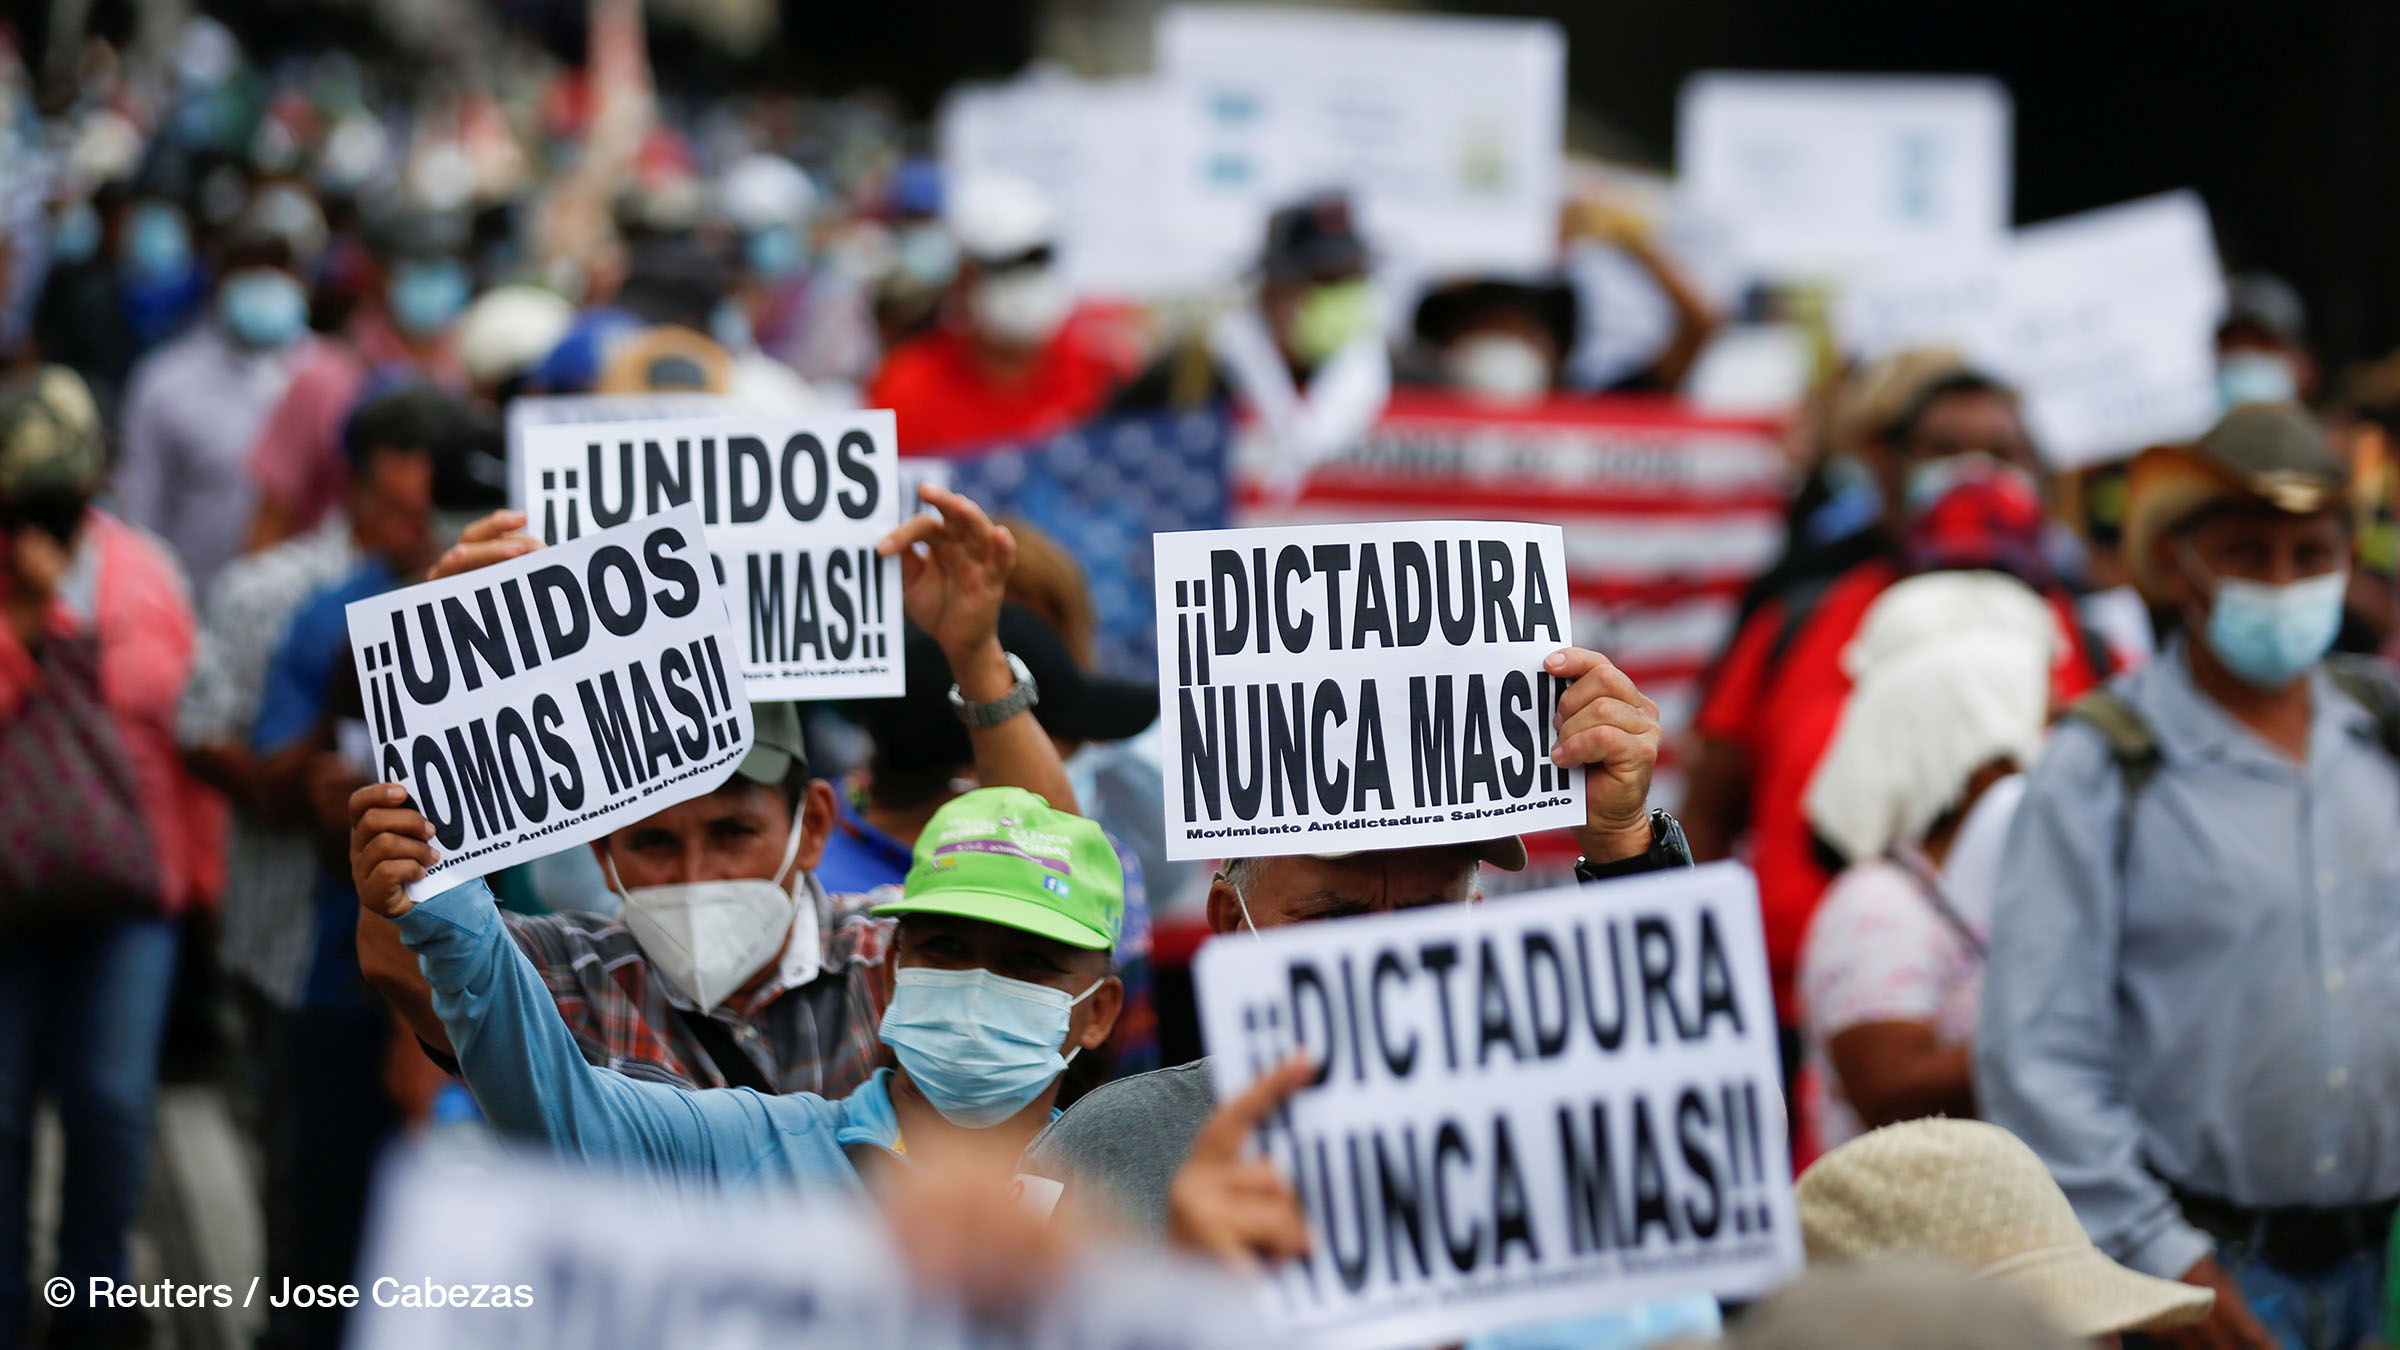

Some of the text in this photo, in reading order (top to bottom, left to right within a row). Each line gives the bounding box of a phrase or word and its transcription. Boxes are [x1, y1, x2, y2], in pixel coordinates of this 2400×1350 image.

[541, 429, 881, 546] ¡¡UNIDOS
[363, 526, 701, 746] ¡¡UNIDOS
[746, 545, 888, 665] MAS!!
[1175, 539, 1561, 687] ¡¡DICTADURA
[577, 634, 743, 797] MAS!!
[1178, 678, 1395, 823] NUNCA
[425, 840, 512, 876] ovimiento
[516, 794, 639, 845] Antidictadura
[1186, 796, 1573, 840] Movimiento Antidictadura Salvadoreño
[1557, 1078, 1774, 1257] MAS!!
